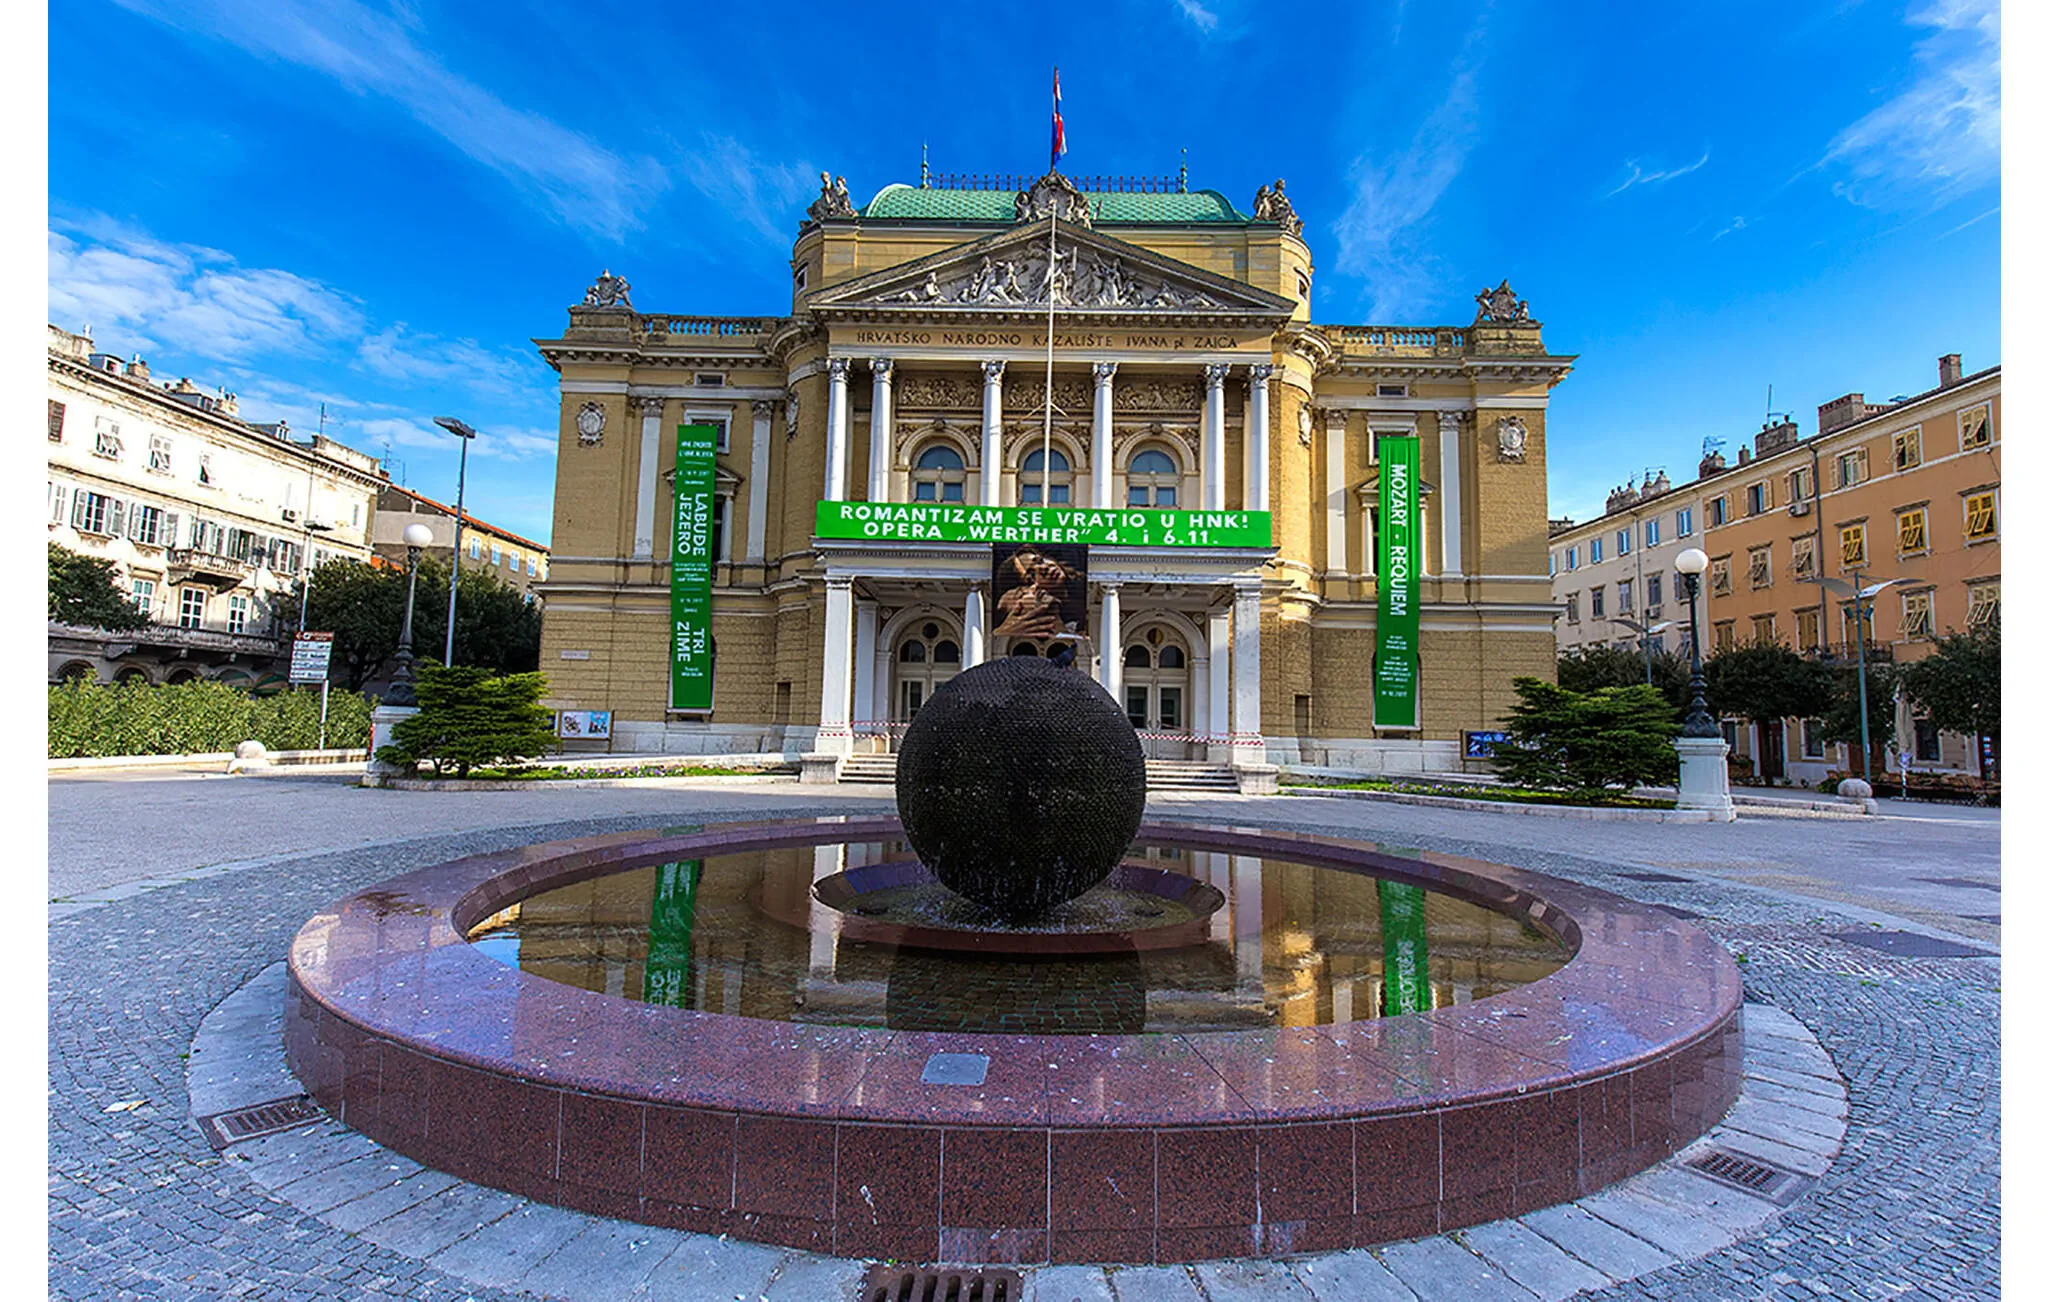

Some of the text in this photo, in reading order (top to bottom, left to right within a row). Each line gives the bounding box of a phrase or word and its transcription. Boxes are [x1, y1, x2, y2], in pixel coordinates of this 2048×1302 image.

[857, 332, 931, 344] HRVATSKO
[943, 333, 1022, 345] NARODNO
[1126, 335, 1168, 347] IVANA
[1390, 464, 1408, 527] MOZART
[677, 492, 692, 555] JEZERO
[692, 493, 708, 556] LABUDE
[840, 505, 1249, 529] ROMANTIZAM SE VRATIO U HNK!
[864, 522, 943, 539] OPERA
[1105, 530, 1127, 543] 4.
[1143, 530, 1149, 543] i
[1164, 530, 1219, 544] 6.11.
[1390, 545, 1408, 616] REQUIEM
[676, 621, 691, 662] ZIME
[692, 627, 705, 654] TRI
